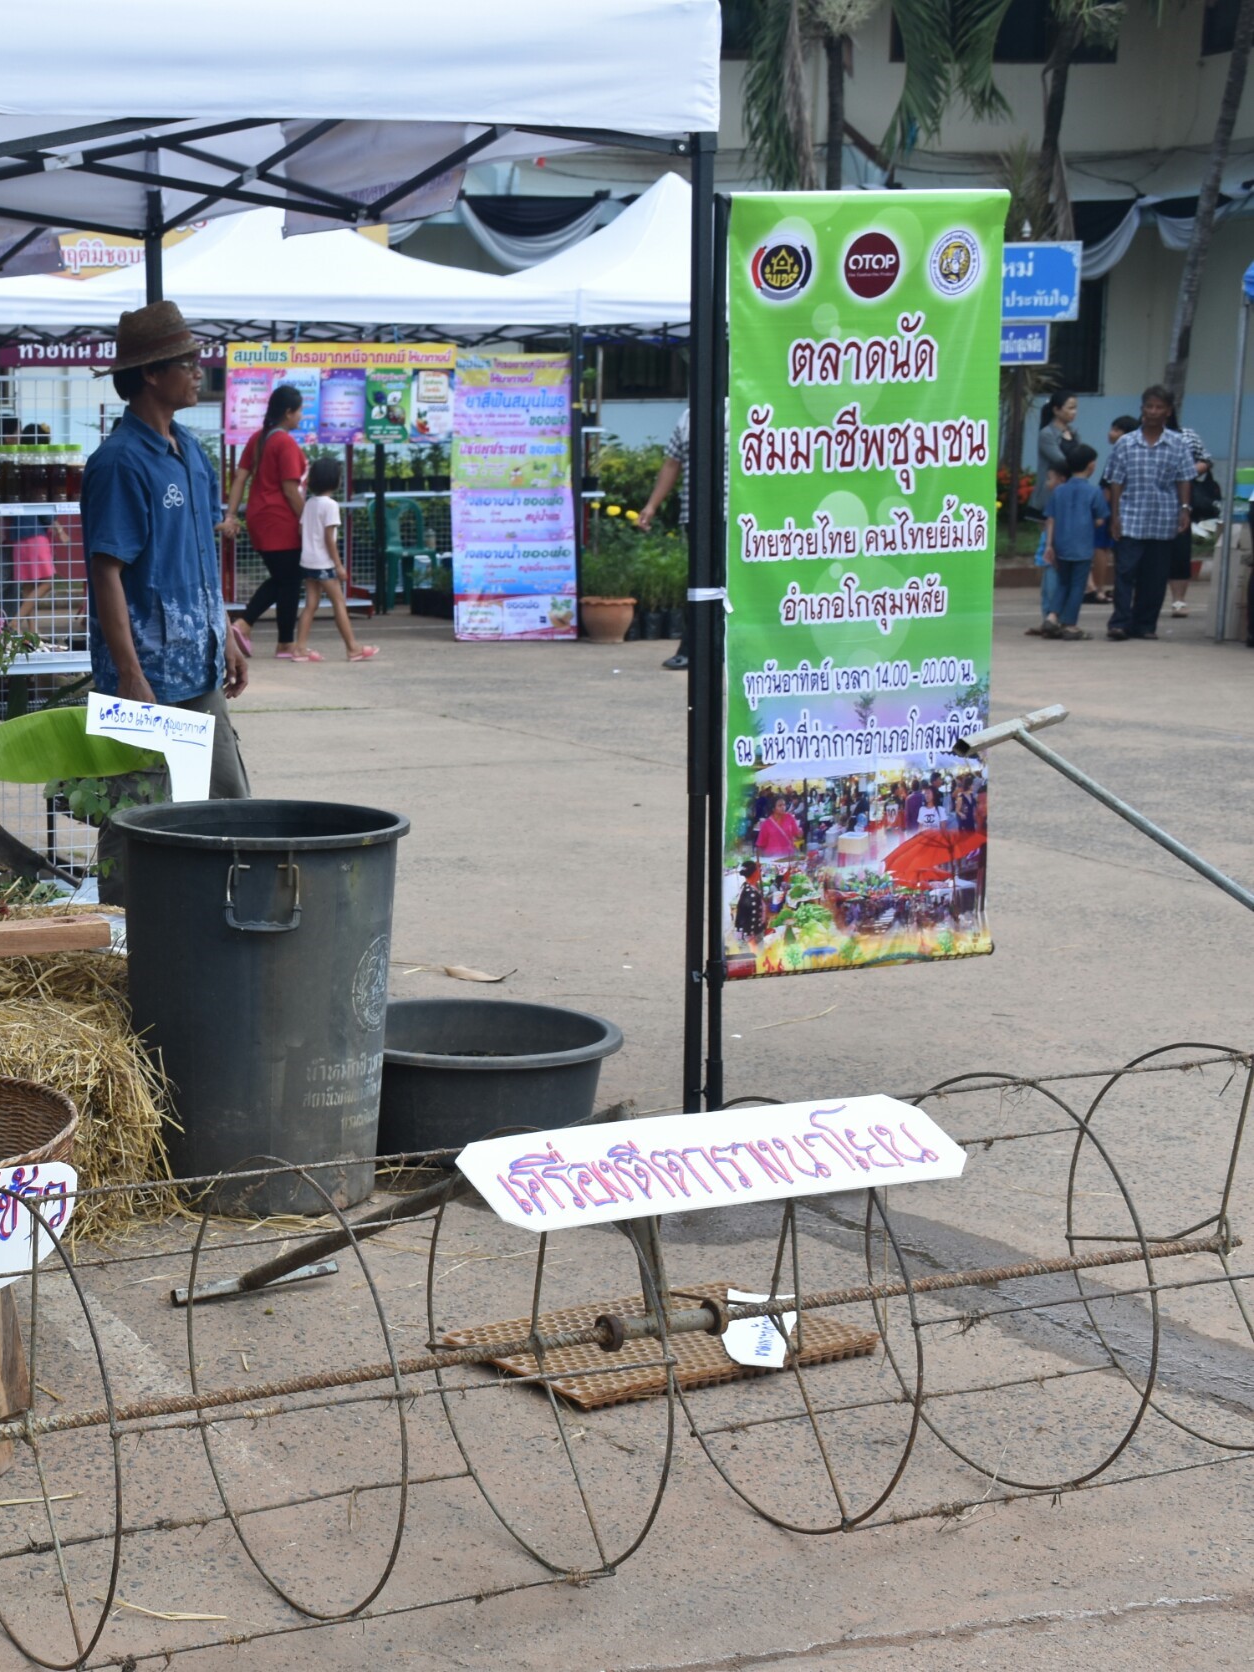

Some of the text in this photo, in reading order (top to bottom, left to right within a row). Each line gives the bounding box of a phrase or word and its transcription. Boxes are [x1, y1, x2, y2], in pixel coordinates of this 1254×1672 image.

[848, 253, 896, 270] OTOP
[233, 346, 287, 366] สมุนไพร
[791, 314, 935, 382] ตลาดนัด
[742, 406, 987, 491] สัมมาชีพชุมชน
[742, 497, 987, 559] ไทยช่วยไทย คนไทยยิ้มได้
[782, 574, 946, 632] อำเภอโกสุมพิสัย
[744, 657, 831, 708] ทุกวันอาทิตย์
[835, 666, 869, 691] เวลา
[875, 665, 908, 688] 14.00
[922, 663, 956, 686] 20.00
[735, 735, 754, 765] ณ
